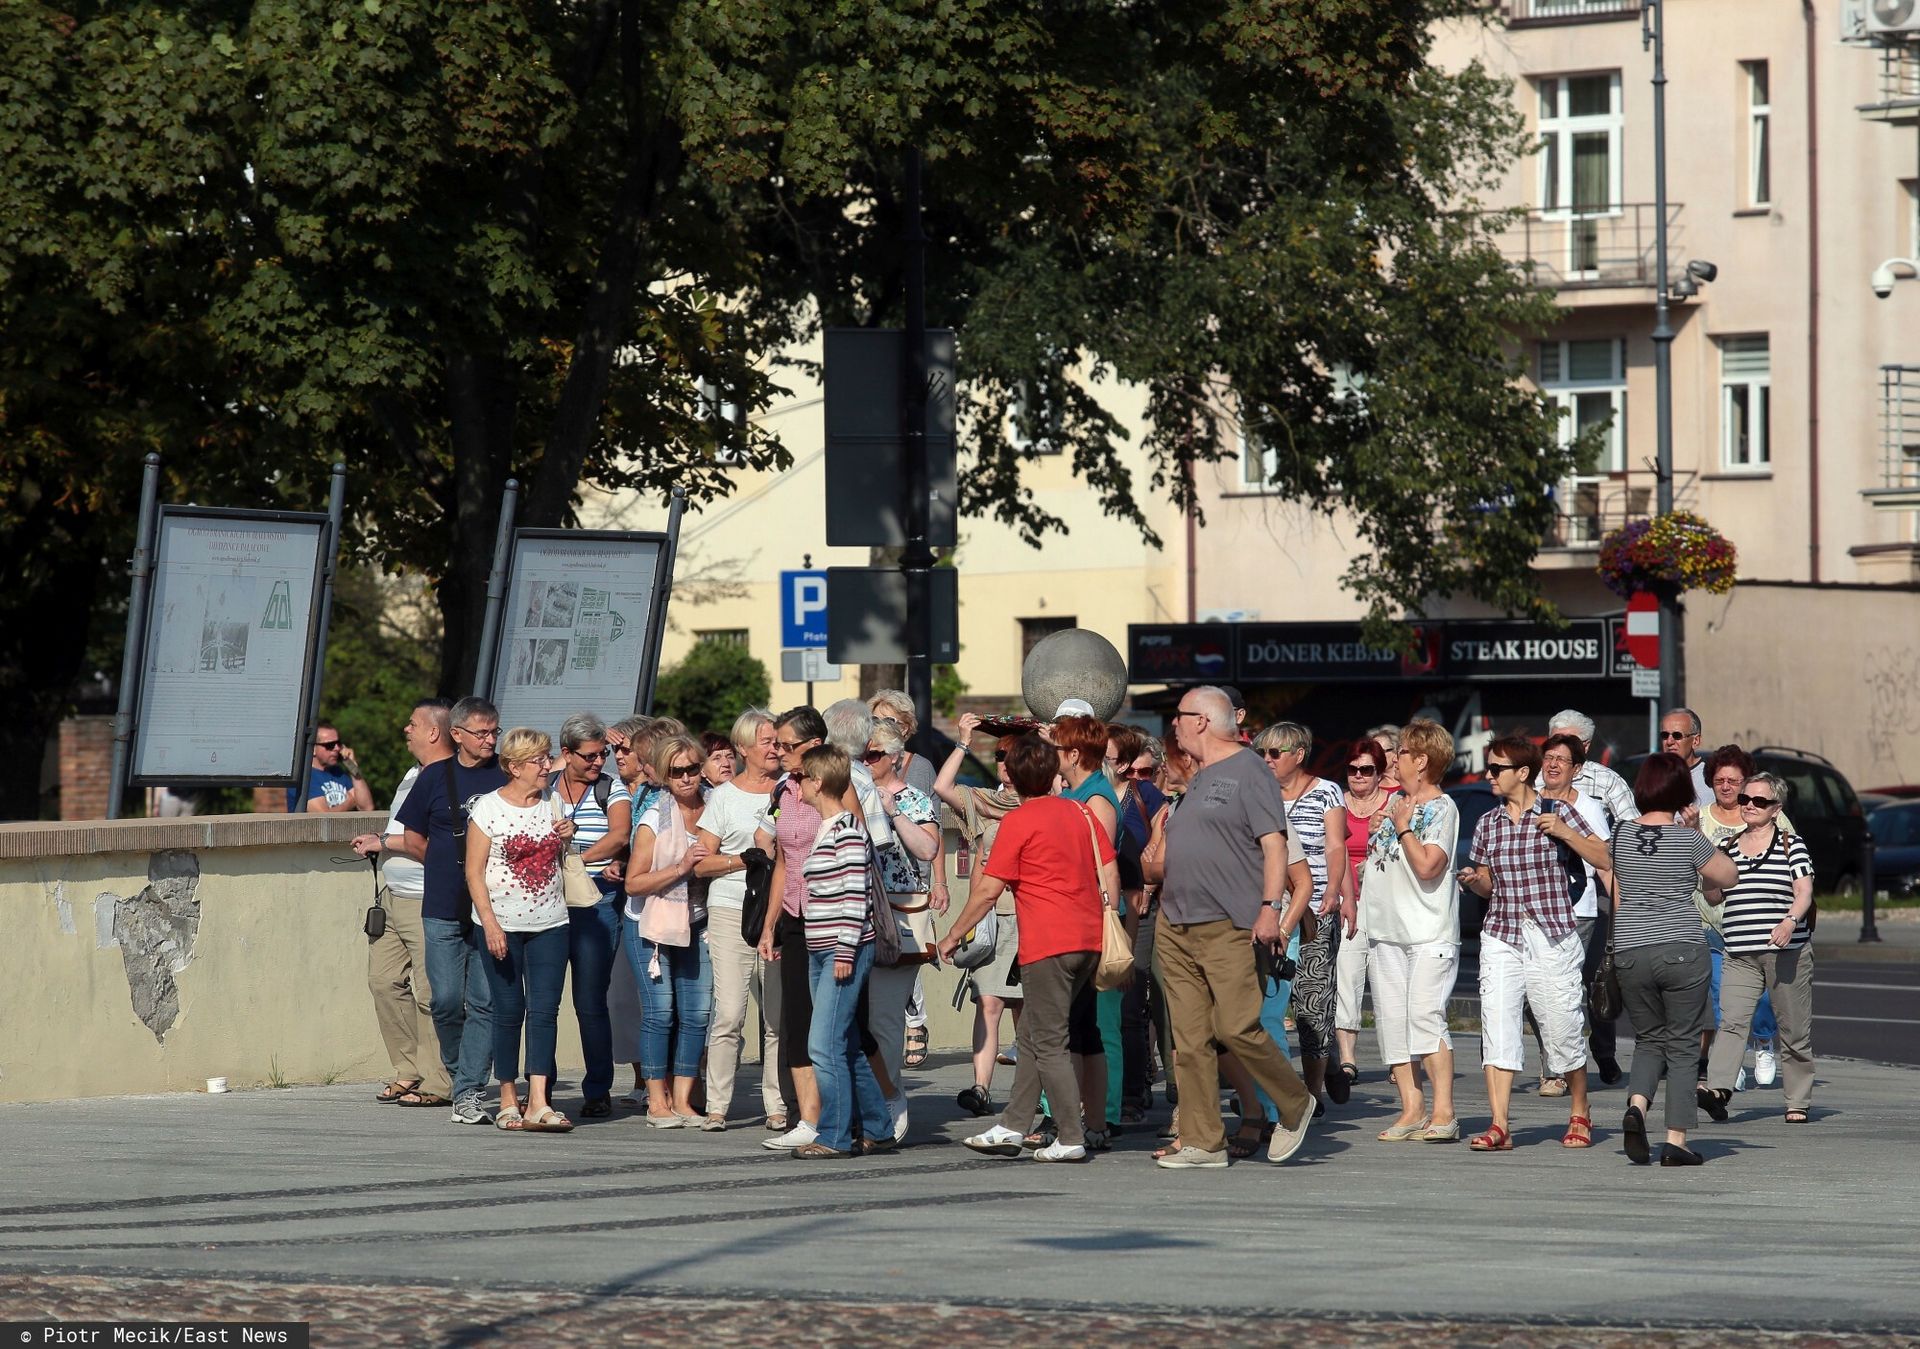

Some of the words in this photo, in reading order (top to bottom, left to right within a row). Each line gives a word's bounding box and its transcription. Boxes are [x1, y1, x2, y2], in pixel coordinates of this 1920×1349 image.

[794, 576, 827, 626] P
[1247, 639, 1324, 663] DÖNER
[1450, 640, 1521, 662] STEAK
[1523, 639, 1599, 660] HOUSE
